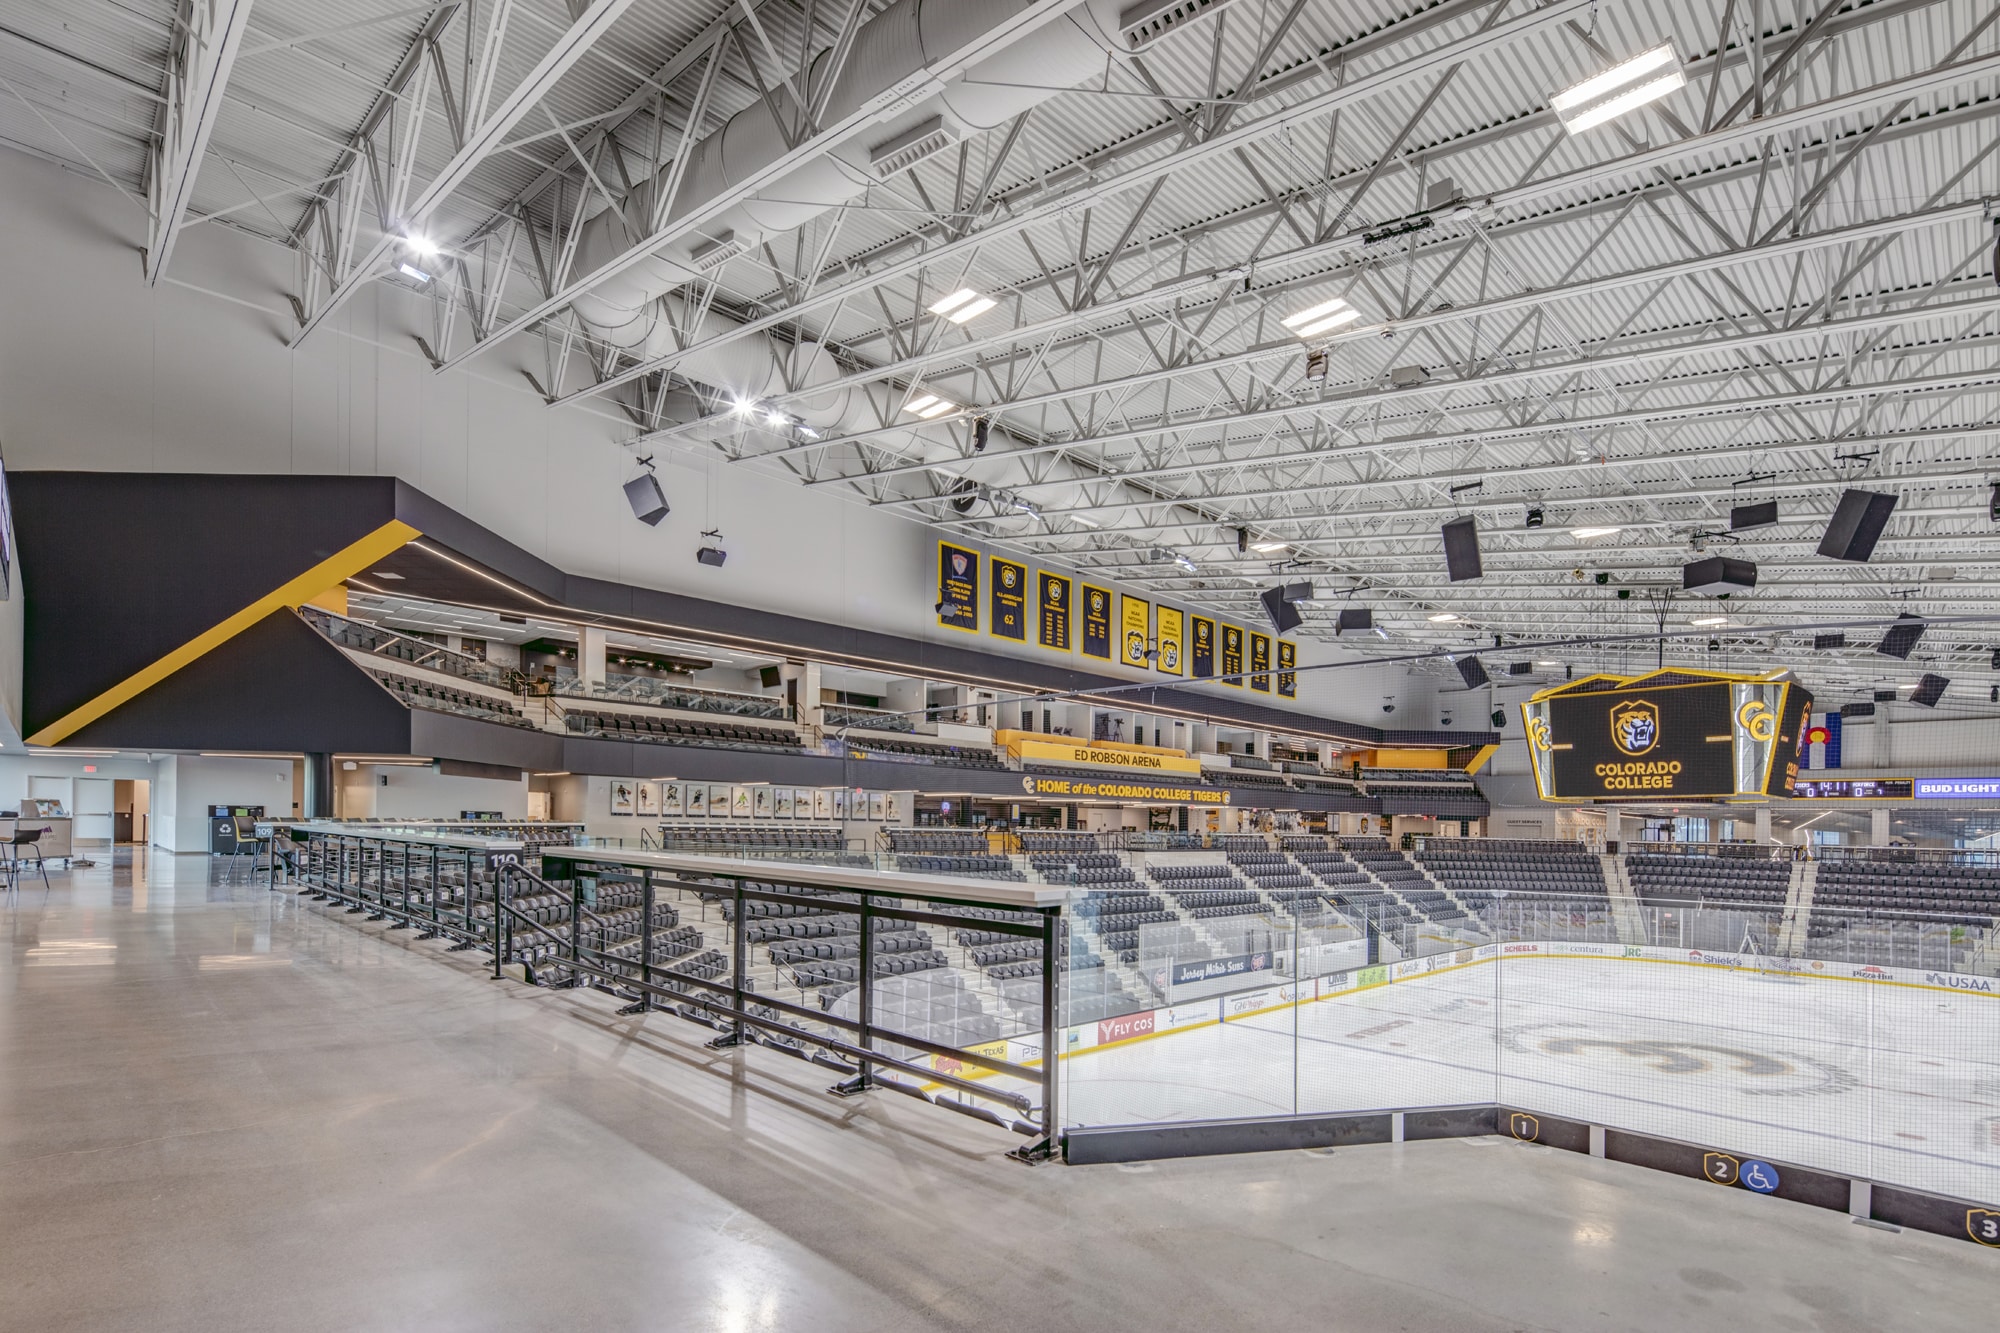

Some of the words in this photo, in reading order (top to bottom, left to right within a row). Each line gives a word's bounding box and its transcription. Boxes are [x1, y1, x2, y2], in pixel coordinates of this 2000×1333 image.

[1004, 614, 1014, 625] 62
[1075, 749, 1088, 761] ED
[1090, 751, 1130, 765] ROBSON
[1132, 755, 1161, 768] ARENA
[1595, 761, 1682, 776] COLORADO
[1604, 775, 1673, 789] COLLEGE
[1921, 784, 1952, 793] BUD
[1954, 784, 1999, 793] LIGHT
[1037, 780, 1070, 794] HOME
[1072, 783, 1082, 794] of
[1083, 784, 1096, 794] the
[1098, 784, 1152, 798] COLORADO
[1153, 787, 1191, 800] COLLEGE
[1193, 790, 1221, 802] TIGERS
[1504, 945, 1538, 953] SCHEELS
[1570, 945, 1603, 953] centura
[1621, 945, 1642, 958] JRC
[1181, 967, 1204, 980] Jersey
[1853, 970, 1876, 979] Pizza
[1948, 976, 1991, 991] USAA
[1114, 1022, 1131, 1036] FLY
[1133, 1018, 1153, 1032] COS
[983, 1046, 1004, 1056] TEXAS
[1022, 1047, 1041, 1058] PE
[1521, 1121, 1527, 1135] 1
[1715, 1161, 1727, 1178] 2
[1981, 1219, 1998, 1238] 3
